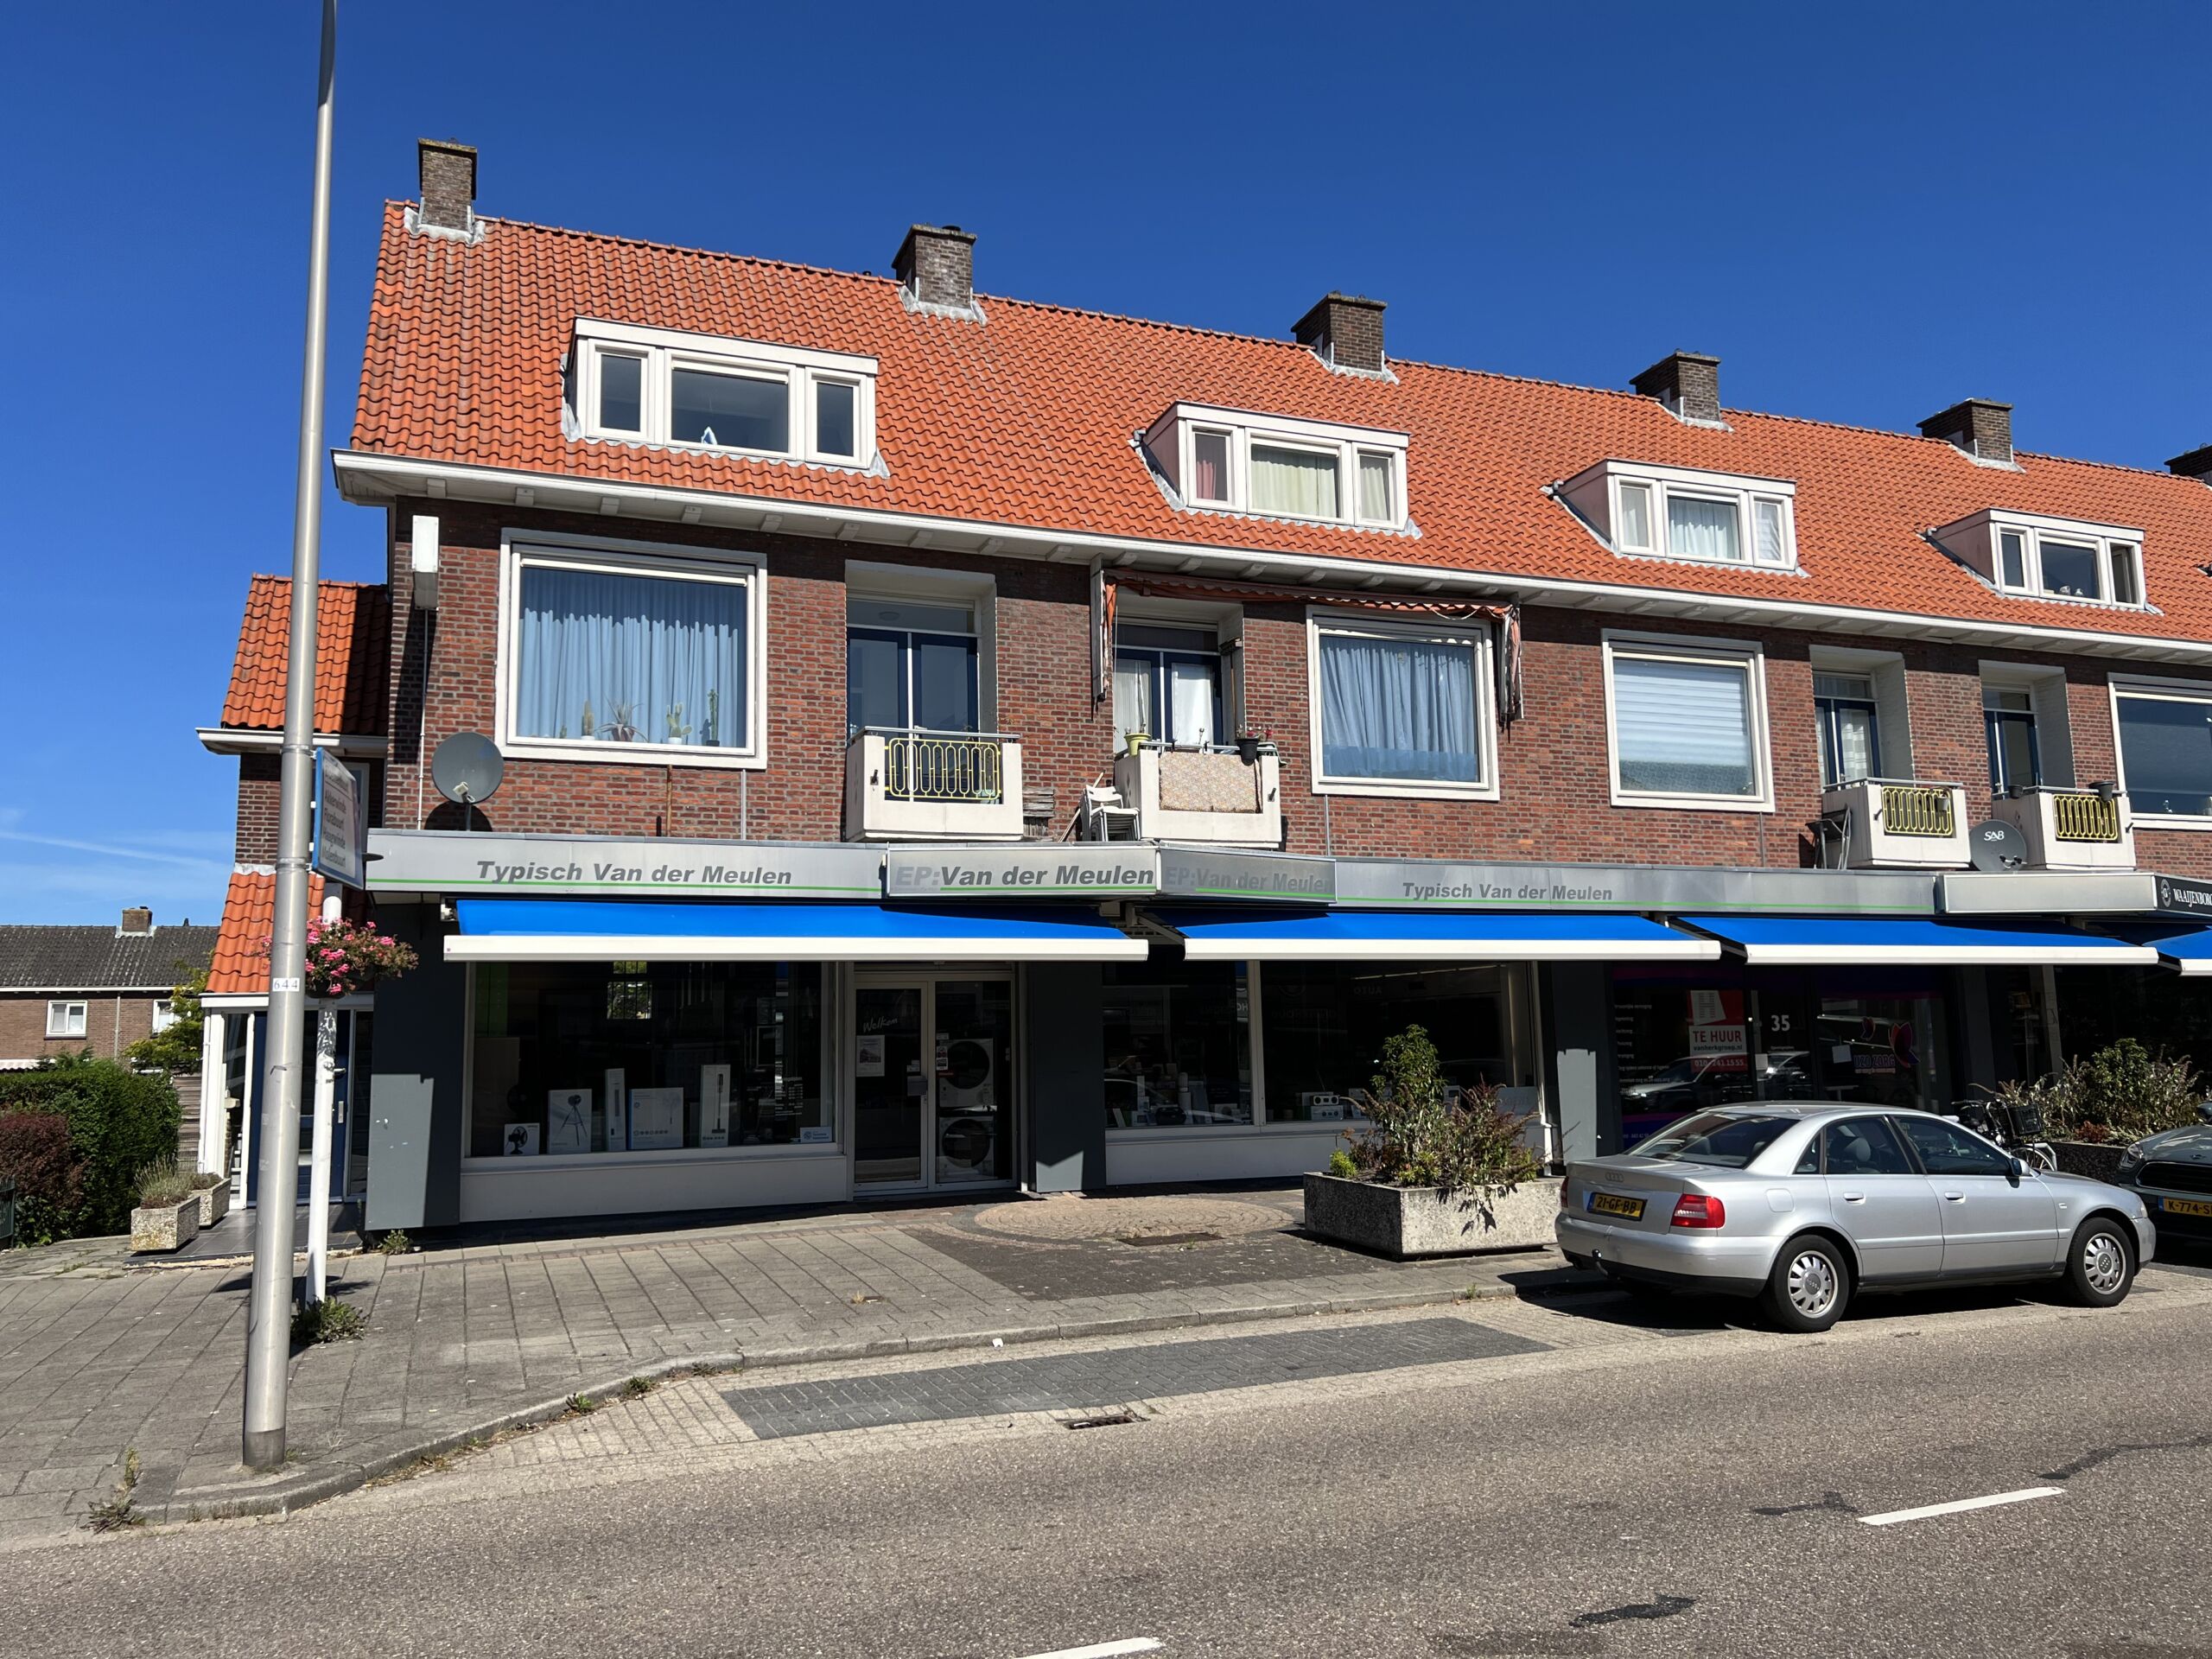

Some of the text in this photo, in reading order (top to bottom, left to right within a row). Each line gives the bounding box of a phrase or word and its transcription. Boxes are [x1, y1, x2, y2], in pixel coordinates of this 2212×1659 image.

[1984, 830, 2005, 841] SAB
[477, 861, 791, 884] Typisch Van der Meulen
[1001, 866, 1048, 886] der
[1055, 866, 1154, 885] Meulen
[1238, 872, 1267, 890] der
[1272, 874, 1334, 893] Meulen
[1402, 882, 1612, 900] Typisch Van der Meulen
[274, 980, 298, 989] 644
[862, 1016, 898, 1033] Welkom
[1770, 1014, 1790, 1032] 35
[1693, 1031, 1742, 1043] TE HUUR
[1872, 1054, 1896, 1068] ZORG
[1596, 1196, 1637, 1214] 21-GF-BB
[2168, 1200, 2212, 1215] K-774-S
